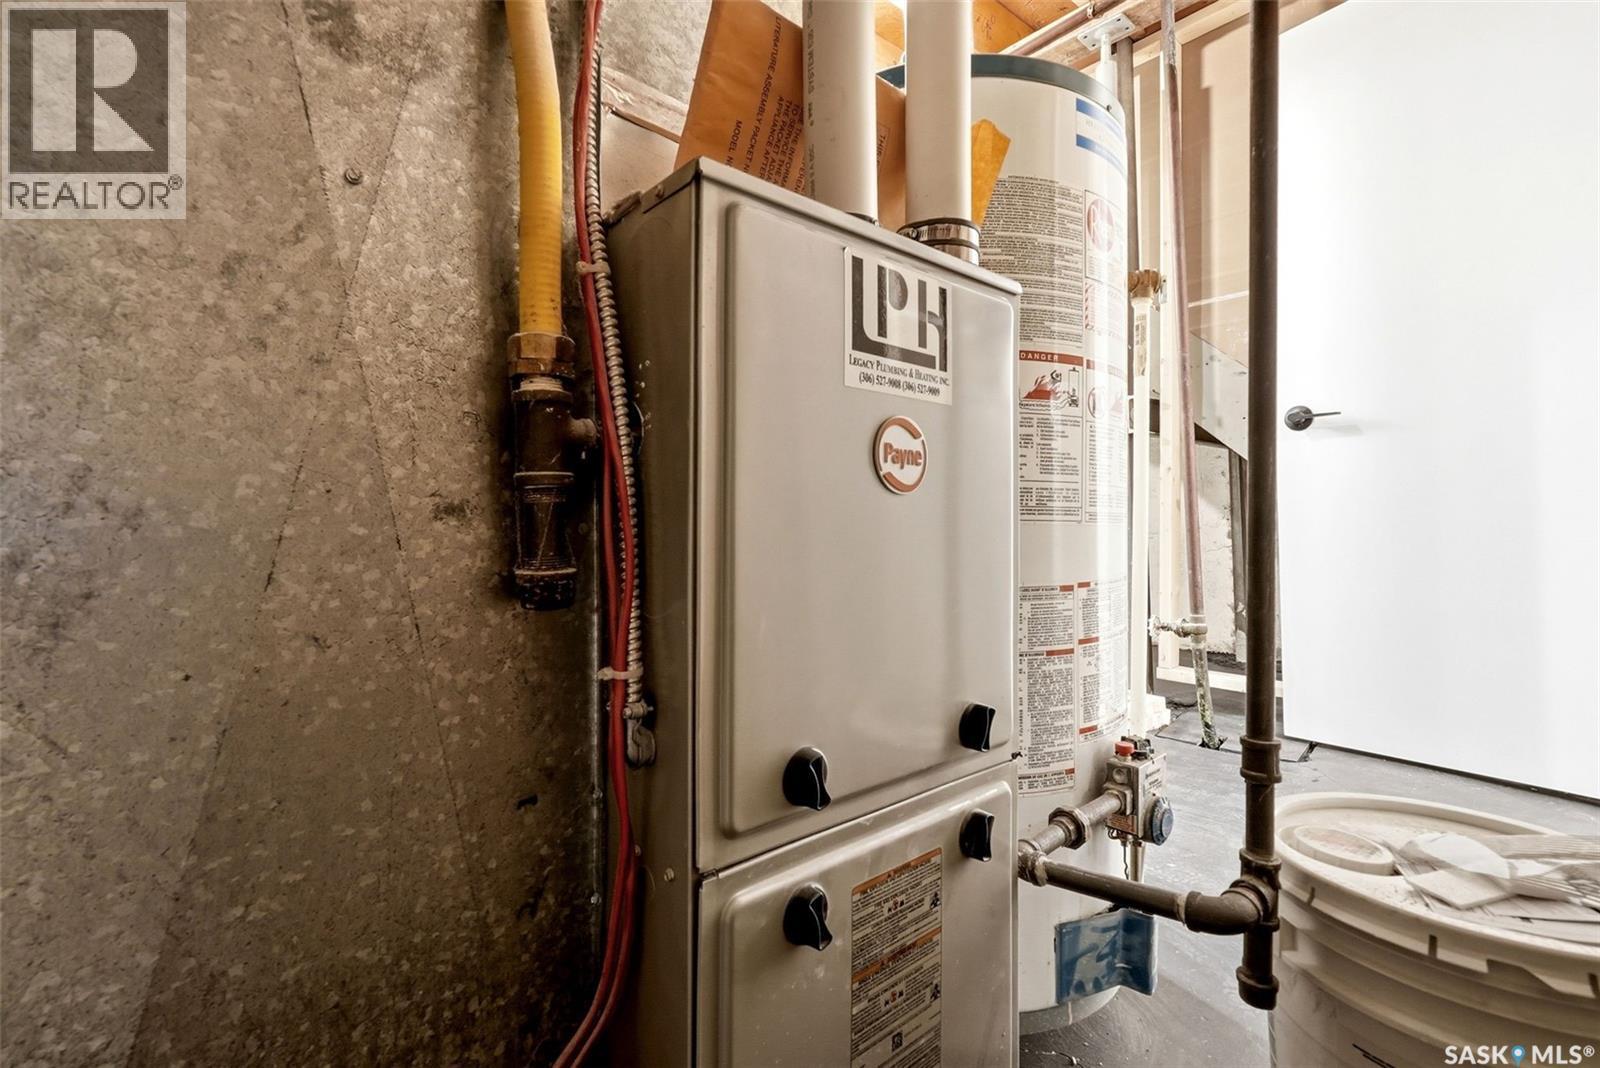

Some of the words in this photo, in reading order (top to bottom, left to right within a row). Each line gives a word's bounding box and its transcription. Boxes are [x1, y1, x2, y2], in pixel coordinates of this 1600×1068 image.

[767, 16, 782, 74] LITERATURE
[756, 73, 773, 126] ASSEMBLY
[728, 119, 743, 153] MODEL
[766, 96, 785, 147] APPLIANCE
[772, 119, 788, 155] PACKET
[779, 119, 796, 157] SERVICE
[747, 125, 760, 163] PACKET
[851, 255, 948, 373] LPH
[908, 368, 914, 379] &
[1020, 351, 1060, 363] DANGER
[859, 371, 875, 386] (306)
[902, 381, 917, 394] (306)
[883, 442, 923, 470] Payne
